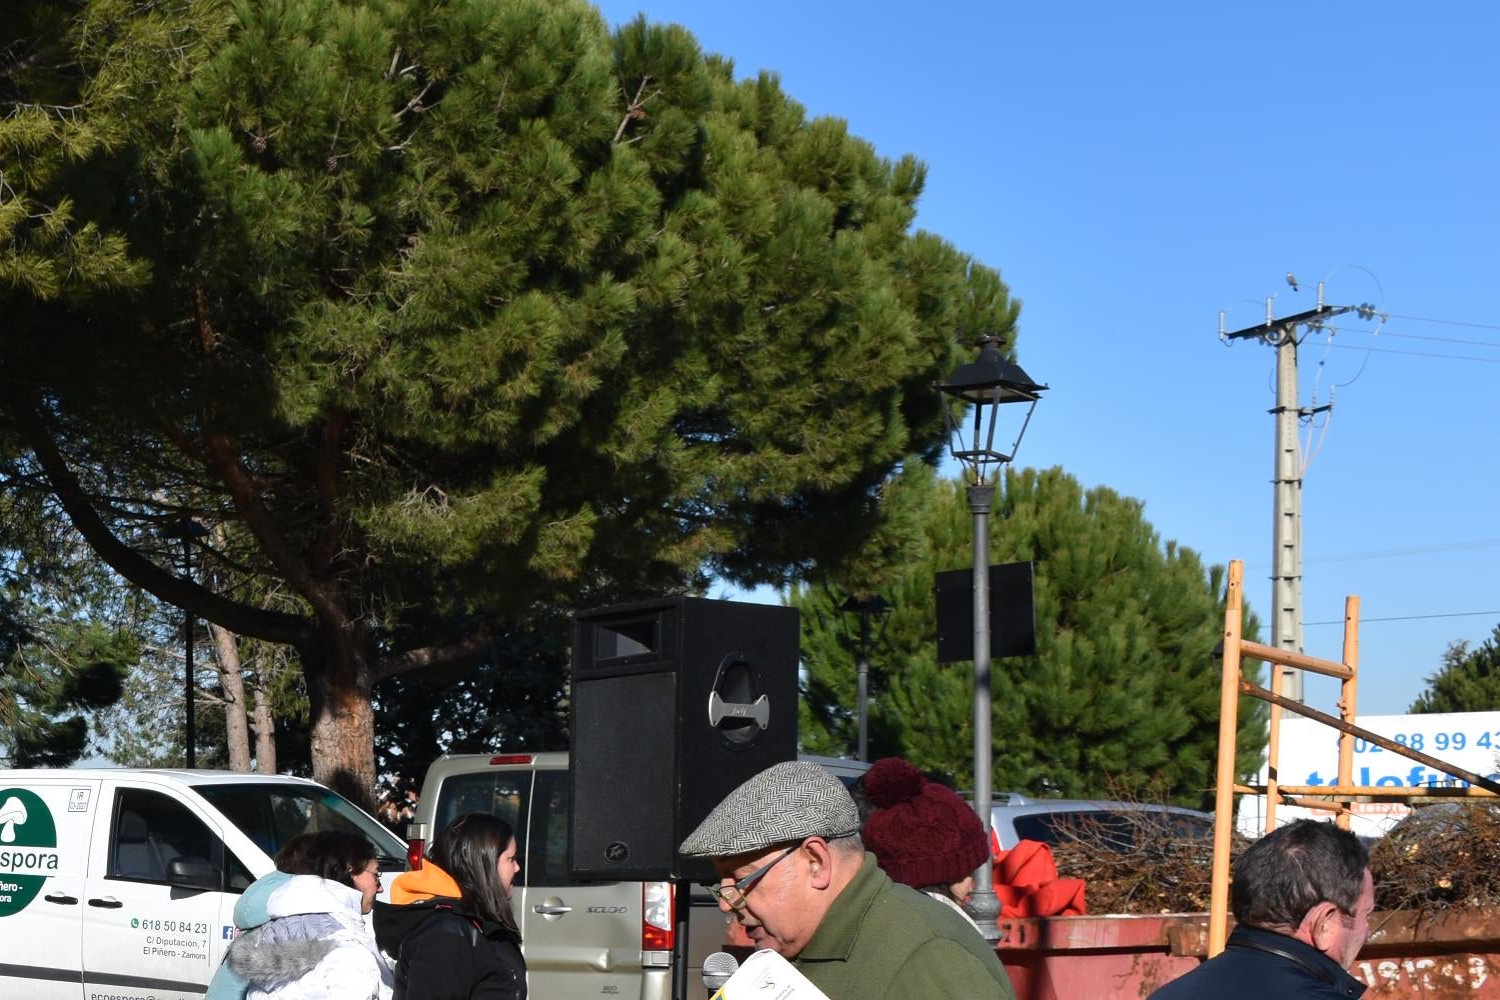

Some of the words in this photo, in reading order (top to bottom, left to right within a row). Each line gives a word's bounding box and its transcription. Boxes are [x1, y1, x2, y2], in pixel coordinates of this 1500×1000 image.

[1434, 732, 1466, 751] 99
[142, 919, 161, 931] 618
[164, 921, 176, 932] 50
[179, 922, 192, 933] 84
[195, 923, 207, 934] 23
[146, 936, 155, 944] C/
[202, 940, 207, 948] 7
[143, 947, 151, 955] El
[152, 947, 176, 958] Piñero
[181, 950, 206, 960] Zamora
